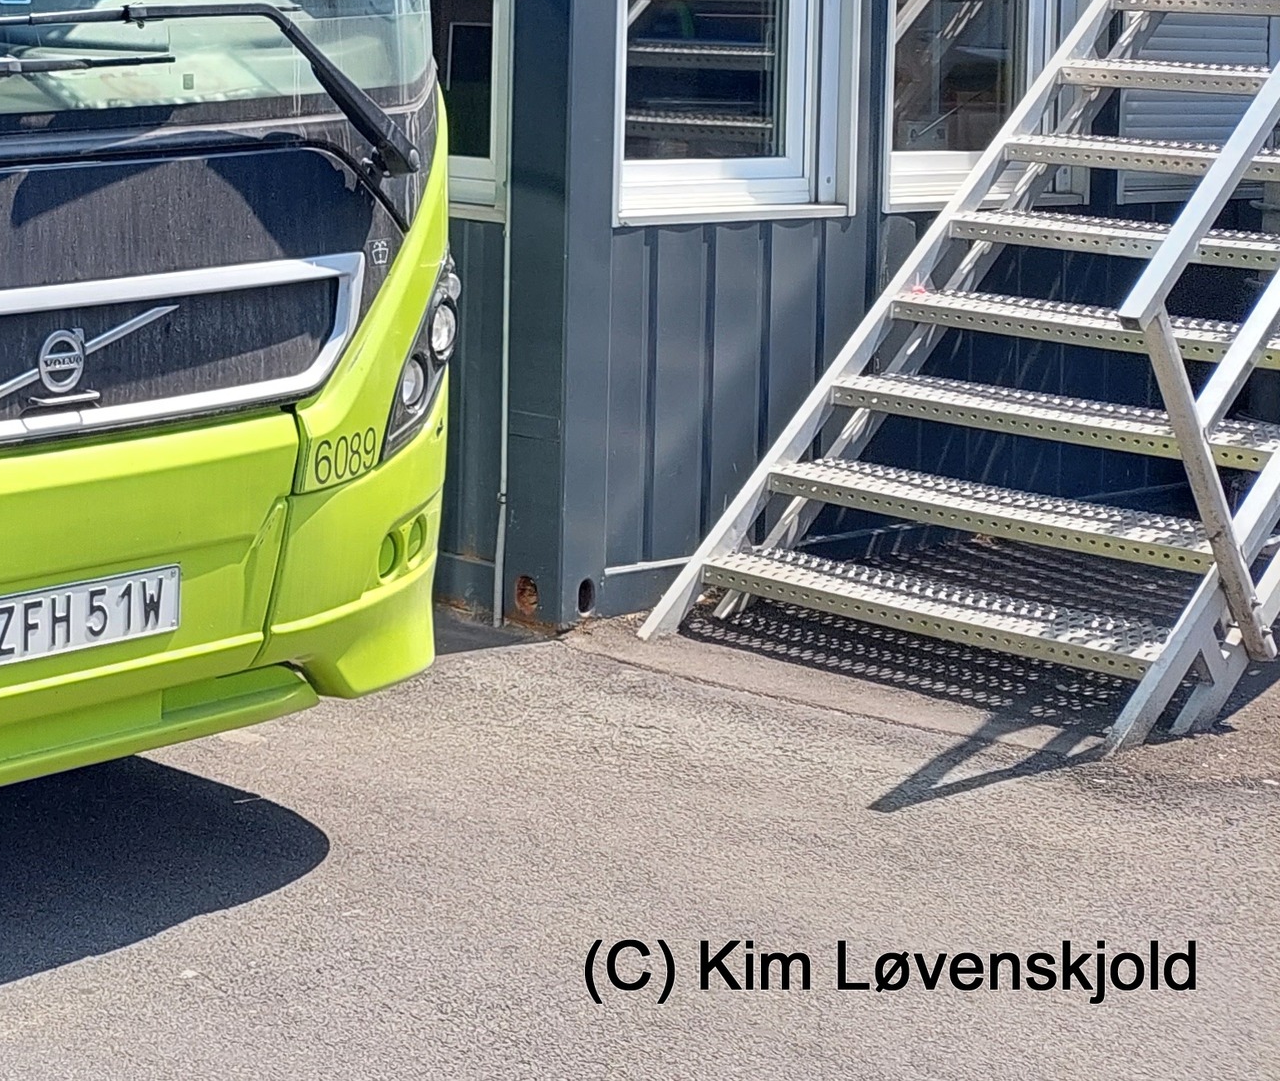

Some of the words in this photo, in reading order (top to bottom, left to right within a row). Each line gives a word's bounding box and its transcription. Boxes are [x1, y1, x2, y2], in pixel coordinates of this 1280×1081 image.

[43, 356, 82, 368] VOLVO
[314, 426, 377, 485] 6089
[88, 575, 165, 637] 51W
